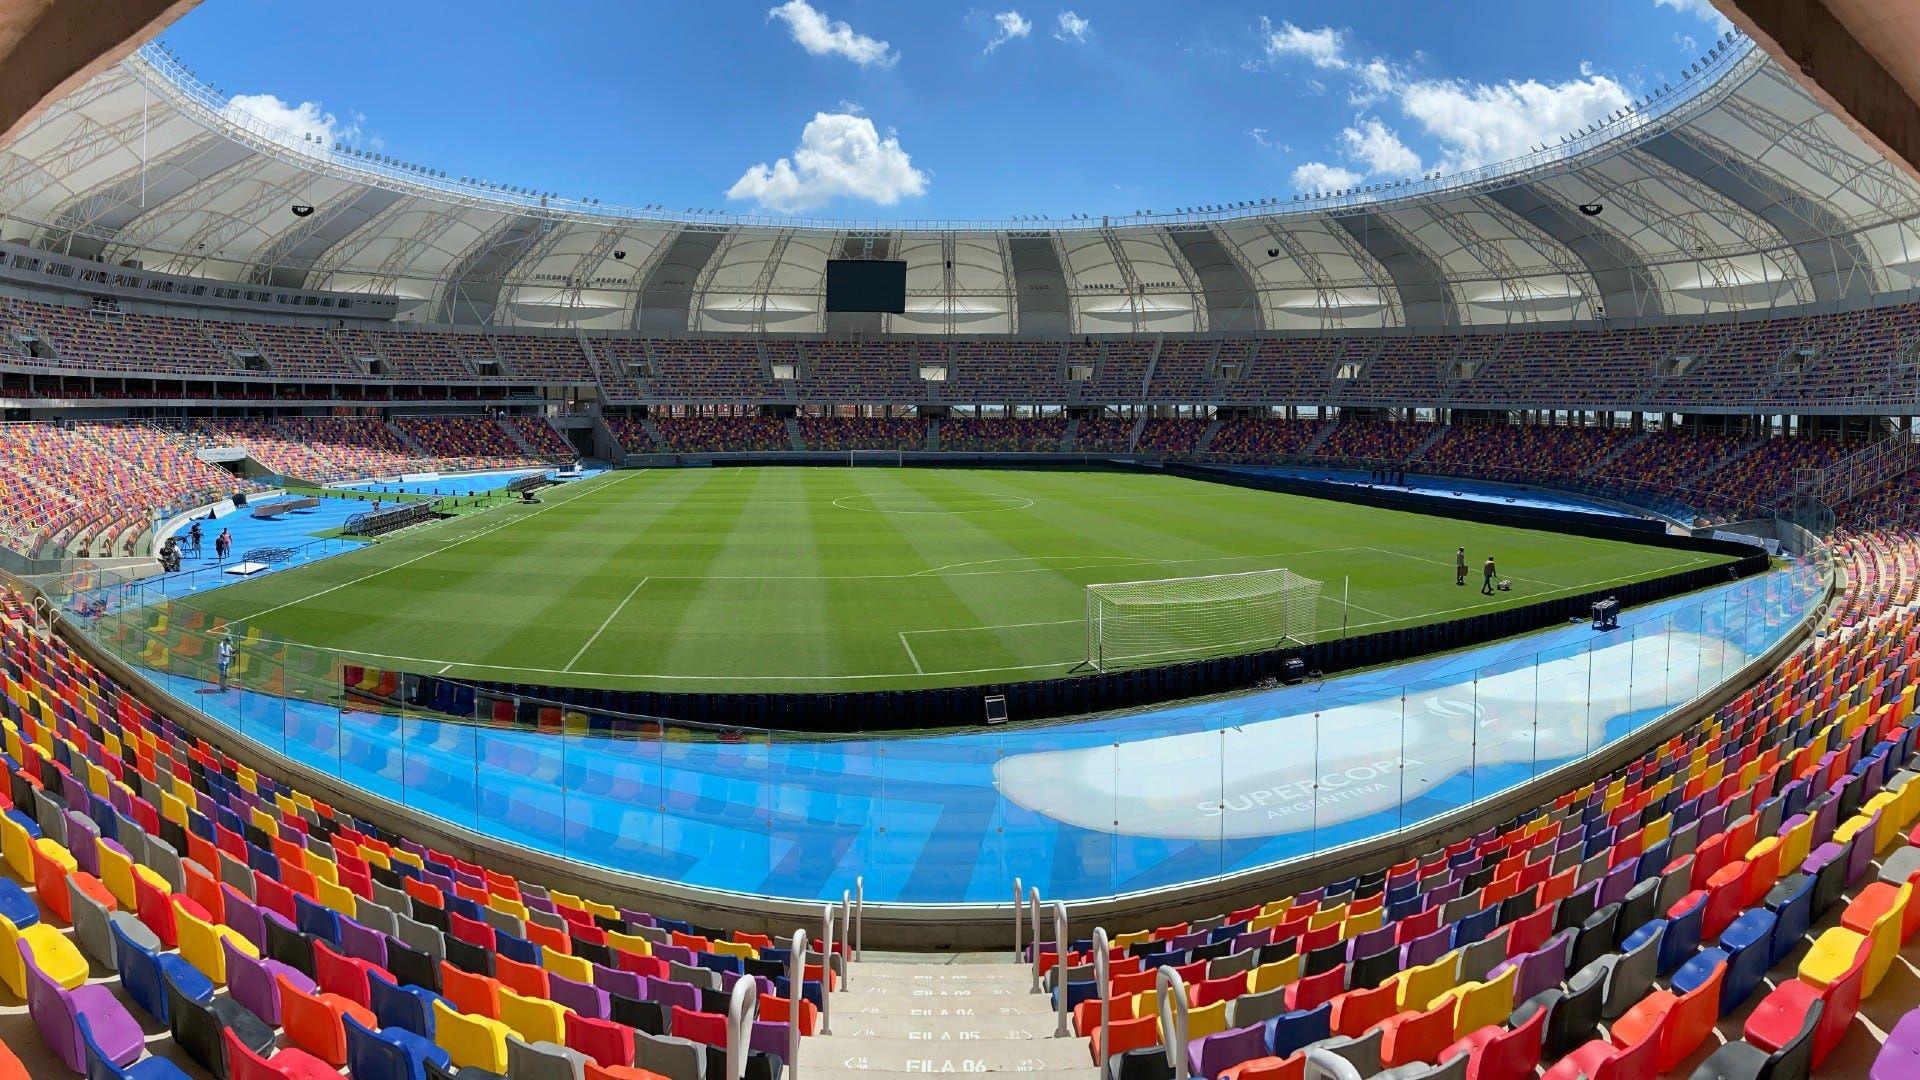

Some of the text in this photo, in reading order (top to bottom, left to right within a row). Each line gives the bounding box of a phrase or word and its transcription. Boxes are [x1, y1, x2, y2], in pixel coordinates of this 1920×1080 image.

[1197, 756, 1424, 817] SUPERCOPA
[1266, 782, 1389, 820] ARGENTINA
[906, 1059, 987, 1073] FILA 06
